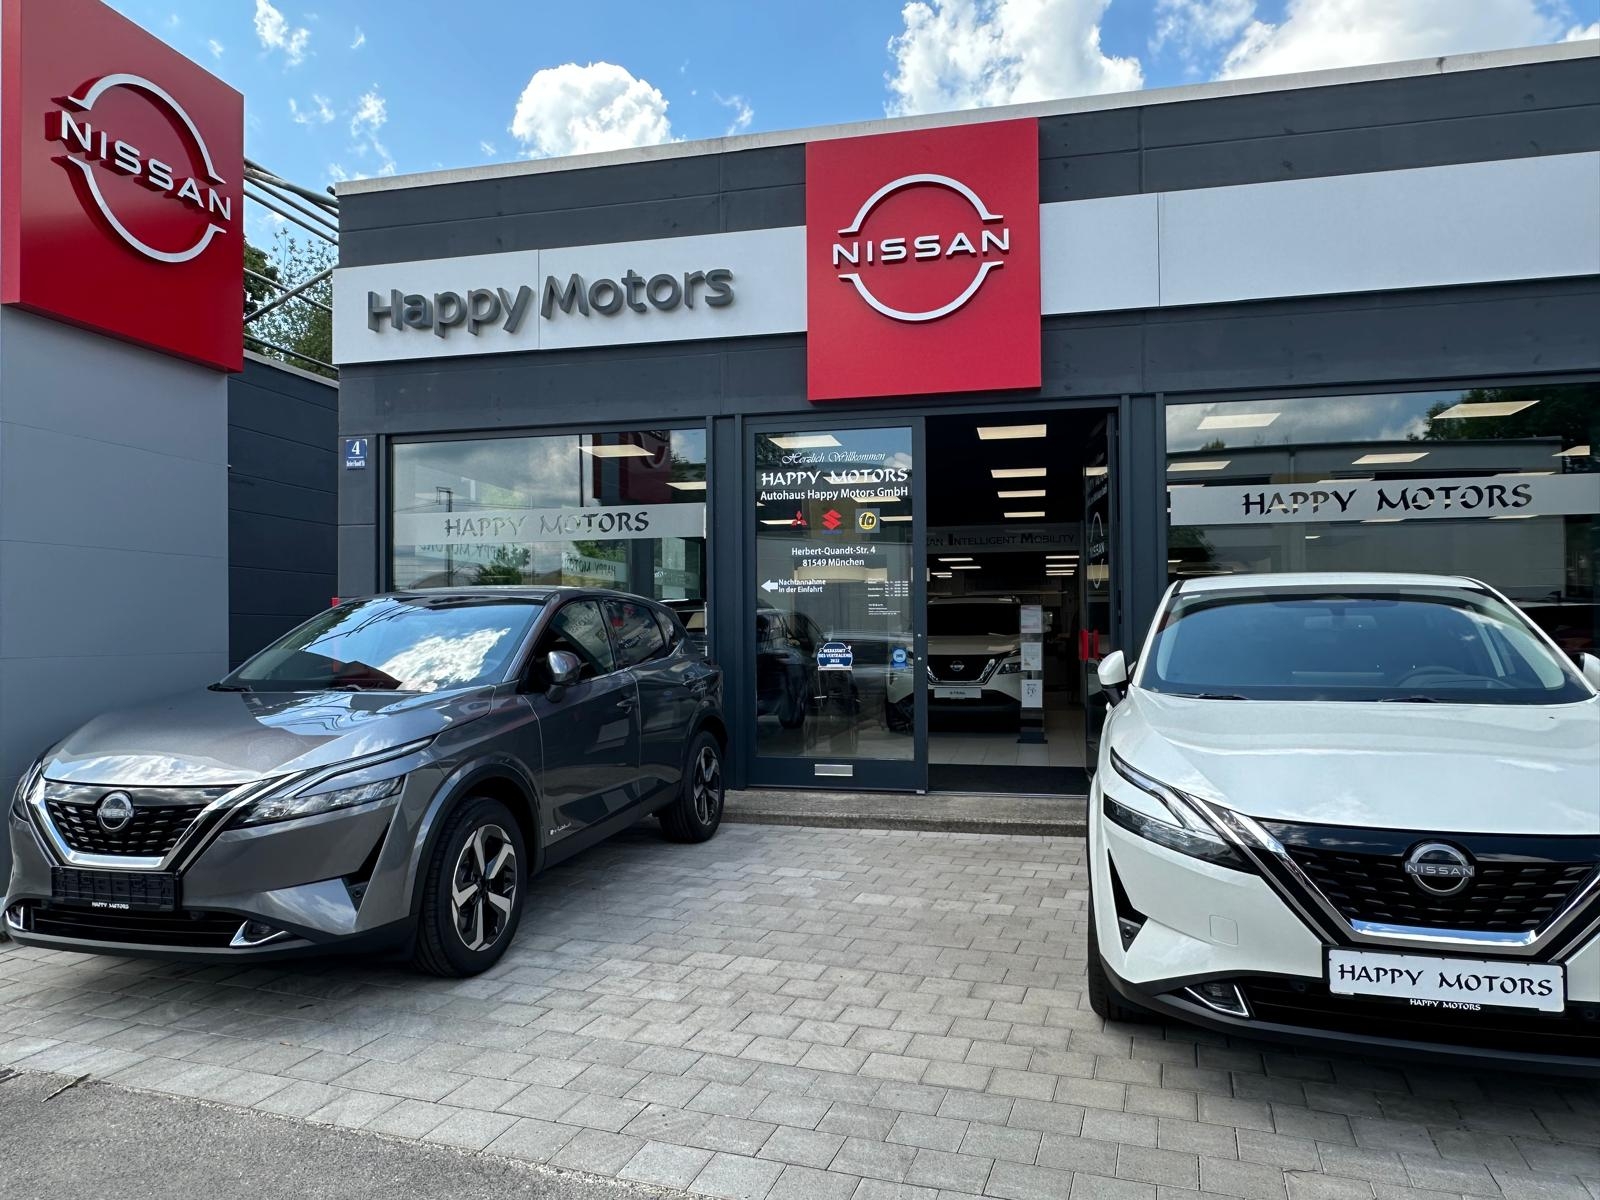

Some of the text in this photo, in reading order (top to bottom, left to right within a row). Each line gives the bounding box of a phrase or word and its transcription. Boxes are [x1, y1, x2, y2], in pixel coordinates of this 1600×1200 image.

[61, 110, 231, 221] NISSAN
[832, 228, 1010, 266] NISSAN
[367, 268, 734, 339] Happy Motors
[351, 440, 361, 455] 4
[780, 451, 886, 464] Herzlich Willkommen
[761, 468, 909, 486] HAPPY MOTORS
[760, 486, 908, 501] Autohaus Happy Motors GmbH
[1242, 483, 1533, 516] HAPPY MOTORS
[444, 510, 650, 538] HAPPY MOTORS
[791, 545, 876, 556] Herbert-Quandt-Str. 4
[802, 557, 865, 567] 81549 München
[1406, 863, 1475, 876] NISSAN
[1338, 963, 1553, 996] HAPPY MOTORS
[1409, 998, 1481, 1011] HAPPY MOTORS
